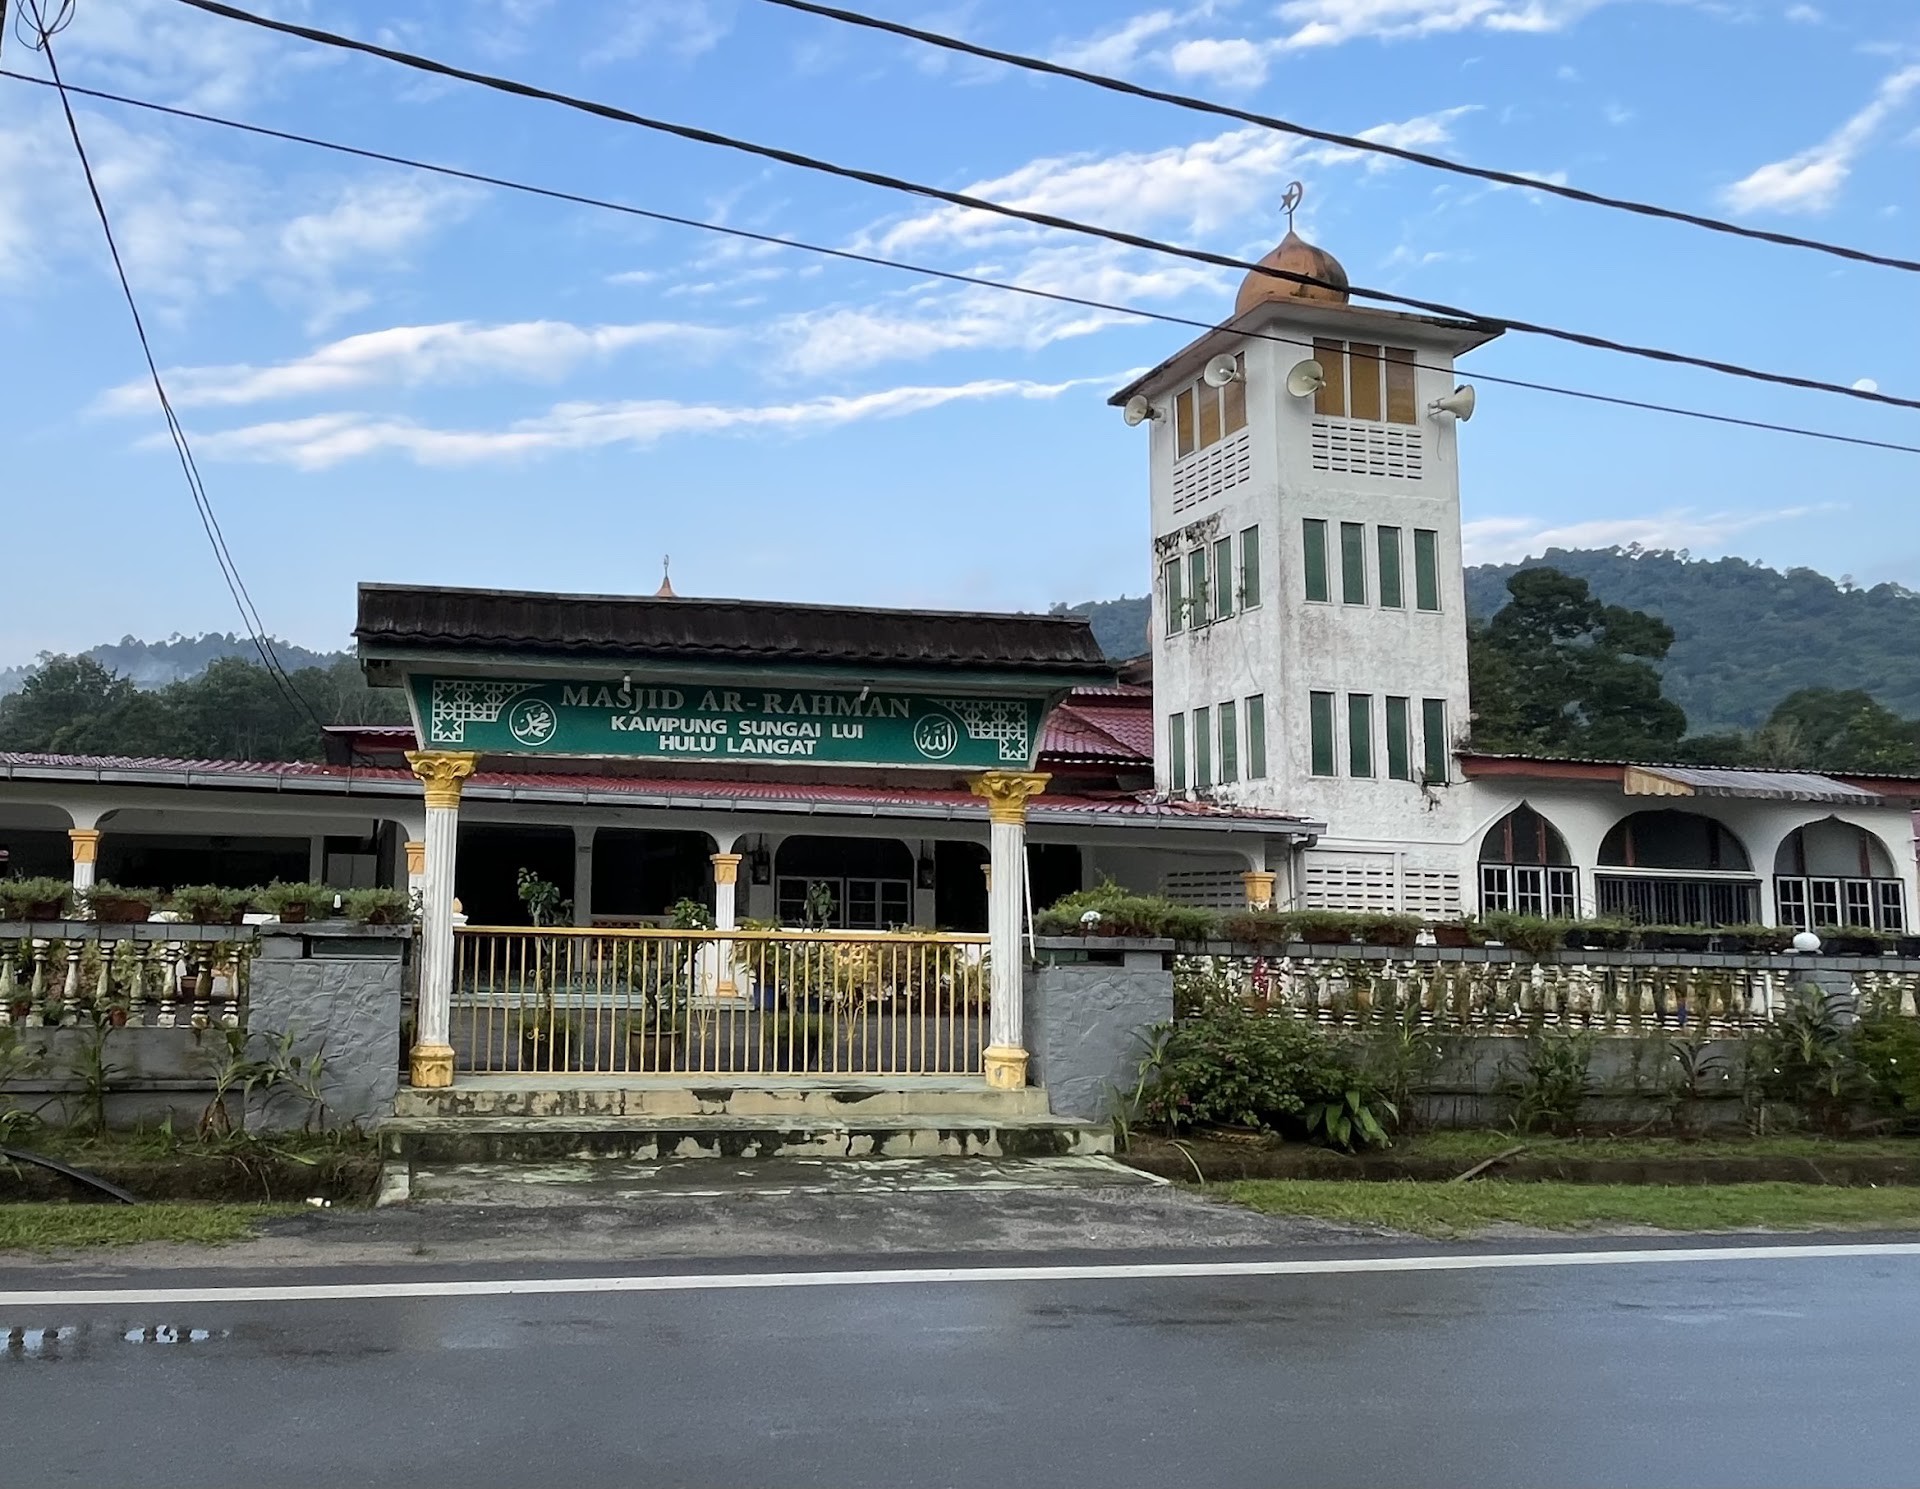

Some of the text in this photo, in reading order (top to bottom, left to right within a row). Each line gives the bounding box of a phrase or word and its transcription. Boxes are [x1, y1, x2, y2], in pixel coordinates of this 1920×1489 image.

[561, 685, 911, 718] MASJID AR-RAHMAN
[611, 715, 863, 739] KAMPUNG SUNGAI LUI
[659, 735, 816, 755] HULU LANGAT
